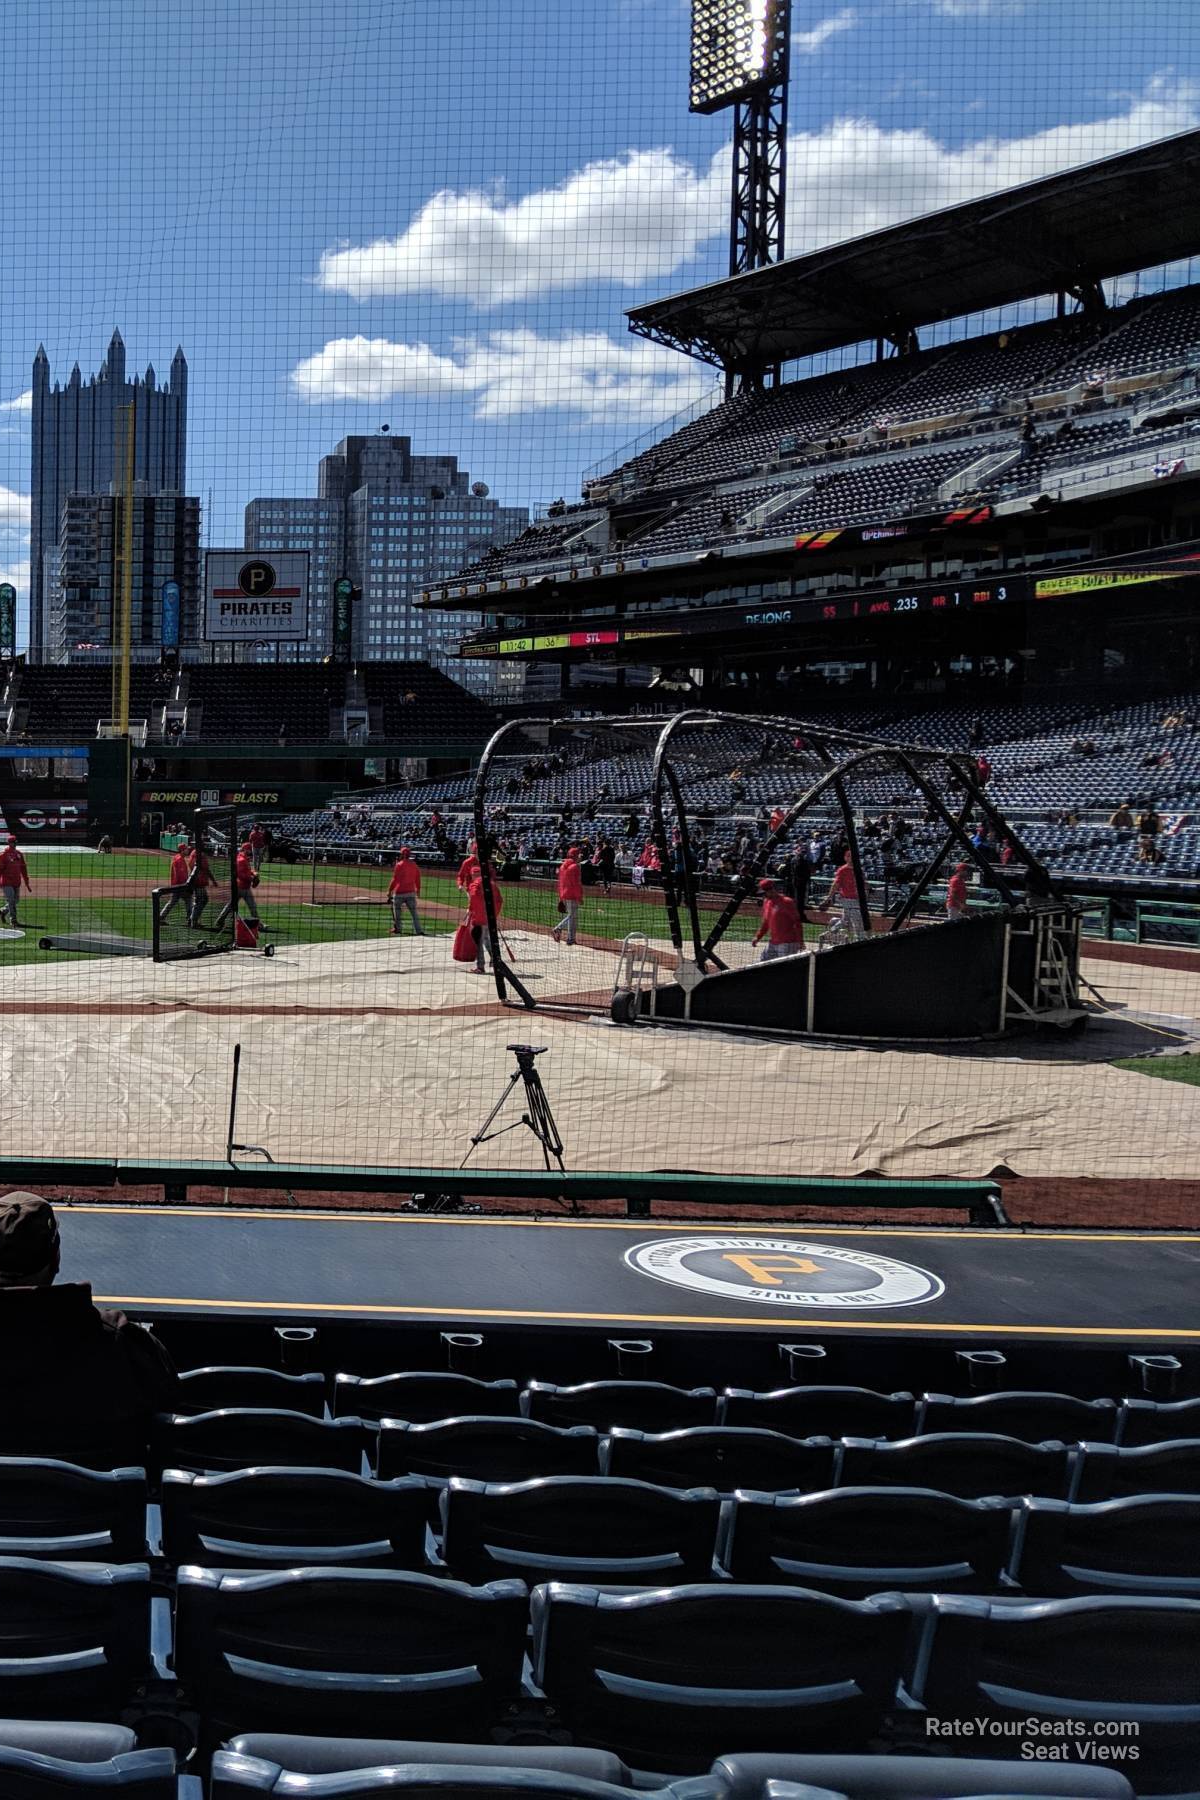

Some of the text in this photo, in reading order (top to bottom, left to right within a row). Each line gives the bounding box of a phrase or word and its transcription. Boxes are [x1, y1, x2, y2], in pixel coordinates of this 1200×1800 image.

[894, 597, 918, 611] .235
[954, 593, 960, 605] 1
[998, 587, 1006, 600] 3
[221, 602, 292, 616] PIRATES
[220, 616, 292, 626] CHARITIES
[585, 632, 600, 643] STL
[150, 792, 198, 802] BOWSER
[232, 793, 279, 803] BLASTS
[716, 1240, 806, 1252] PIRATES
[749, 1289, 824, 1303] SINCE
